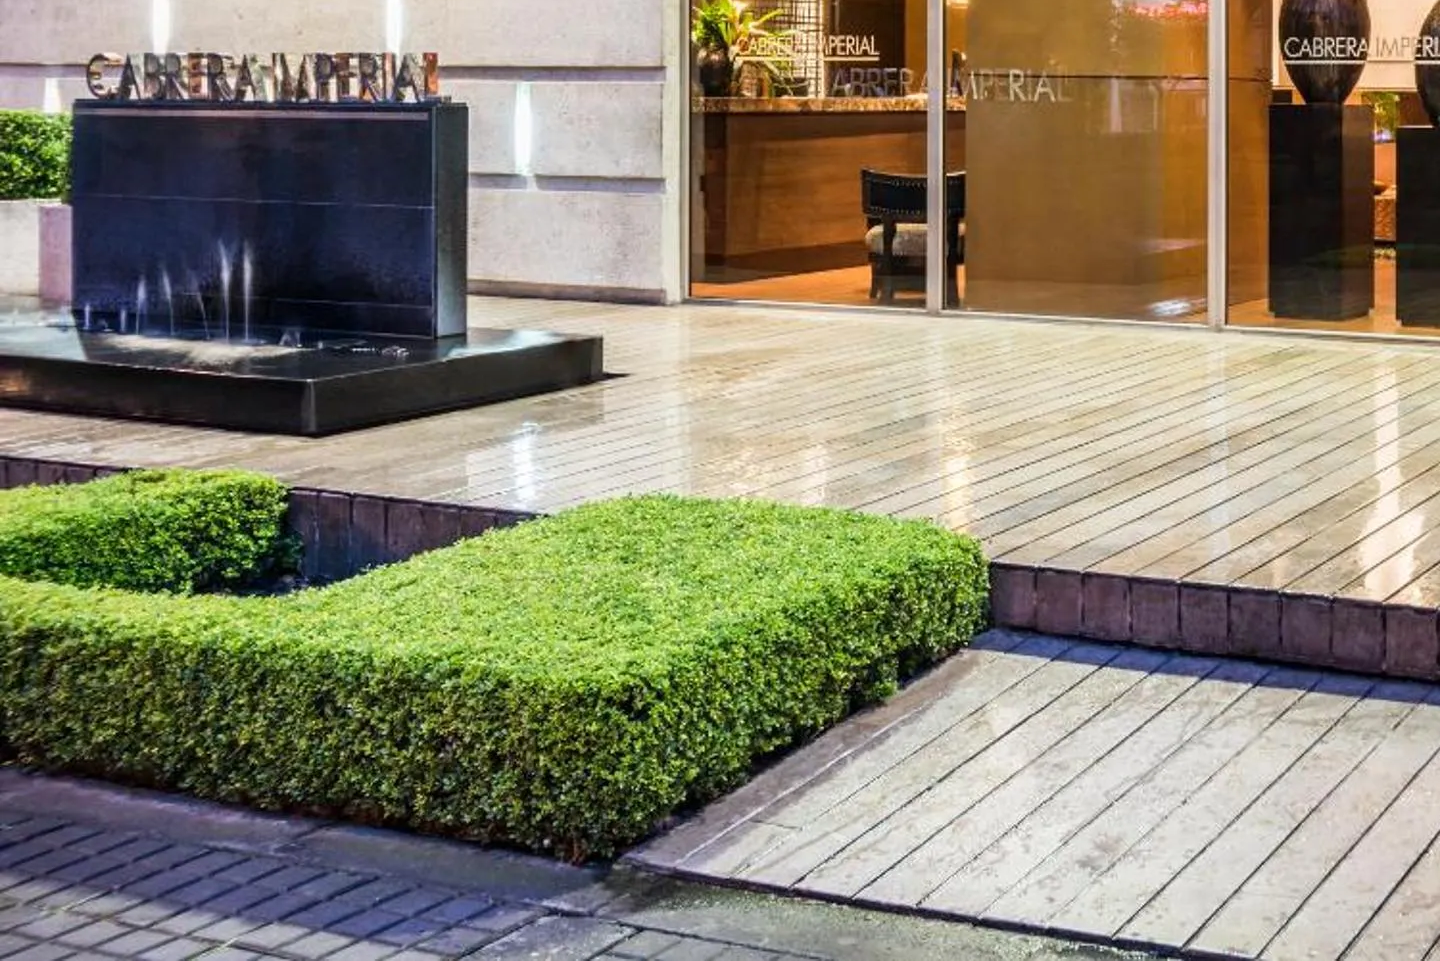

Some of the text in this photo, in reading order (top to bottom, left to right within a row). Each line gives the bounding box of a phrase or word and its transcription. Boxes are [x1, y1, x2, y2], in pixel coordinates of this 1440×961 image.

[1284, 36, 1368, 58] CABRERA
[86, 52, 438, 103] CABRERA IMPERIAL
[829, 67, 929, 97] ABRER
